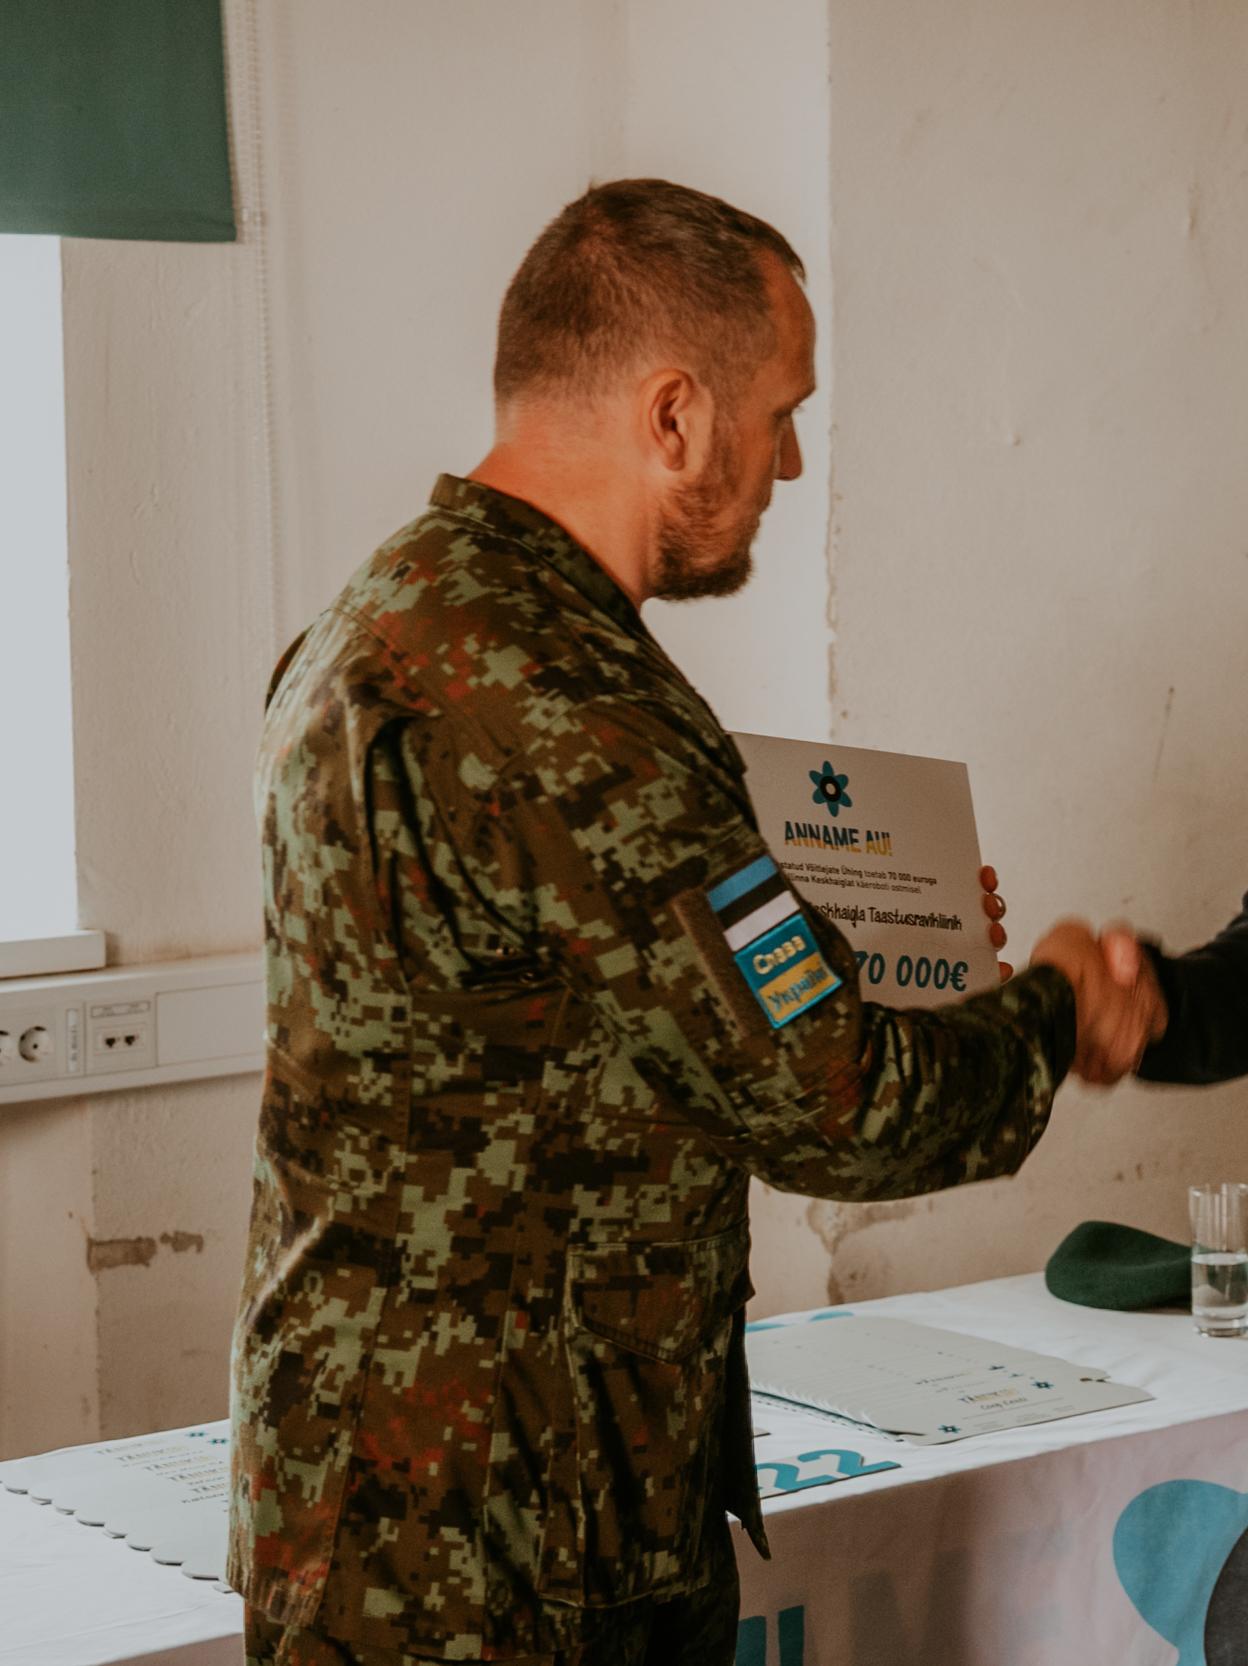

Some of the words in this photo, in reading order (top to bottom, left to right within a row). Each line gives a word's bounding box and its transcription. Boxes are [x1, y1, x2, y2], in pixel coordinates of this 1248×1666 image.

[784, 821, 861, 853] ANNAME
[866, 829, 894, 857] AU!
[912, 875, 937, 886] euroga
[813, 901, 866, 929] eskhaigla
[867, 906, 962, 931] Taastusravikliinik
[896, 955, 969, 992] 000€
[754, 1448, 902, 1492] 22
